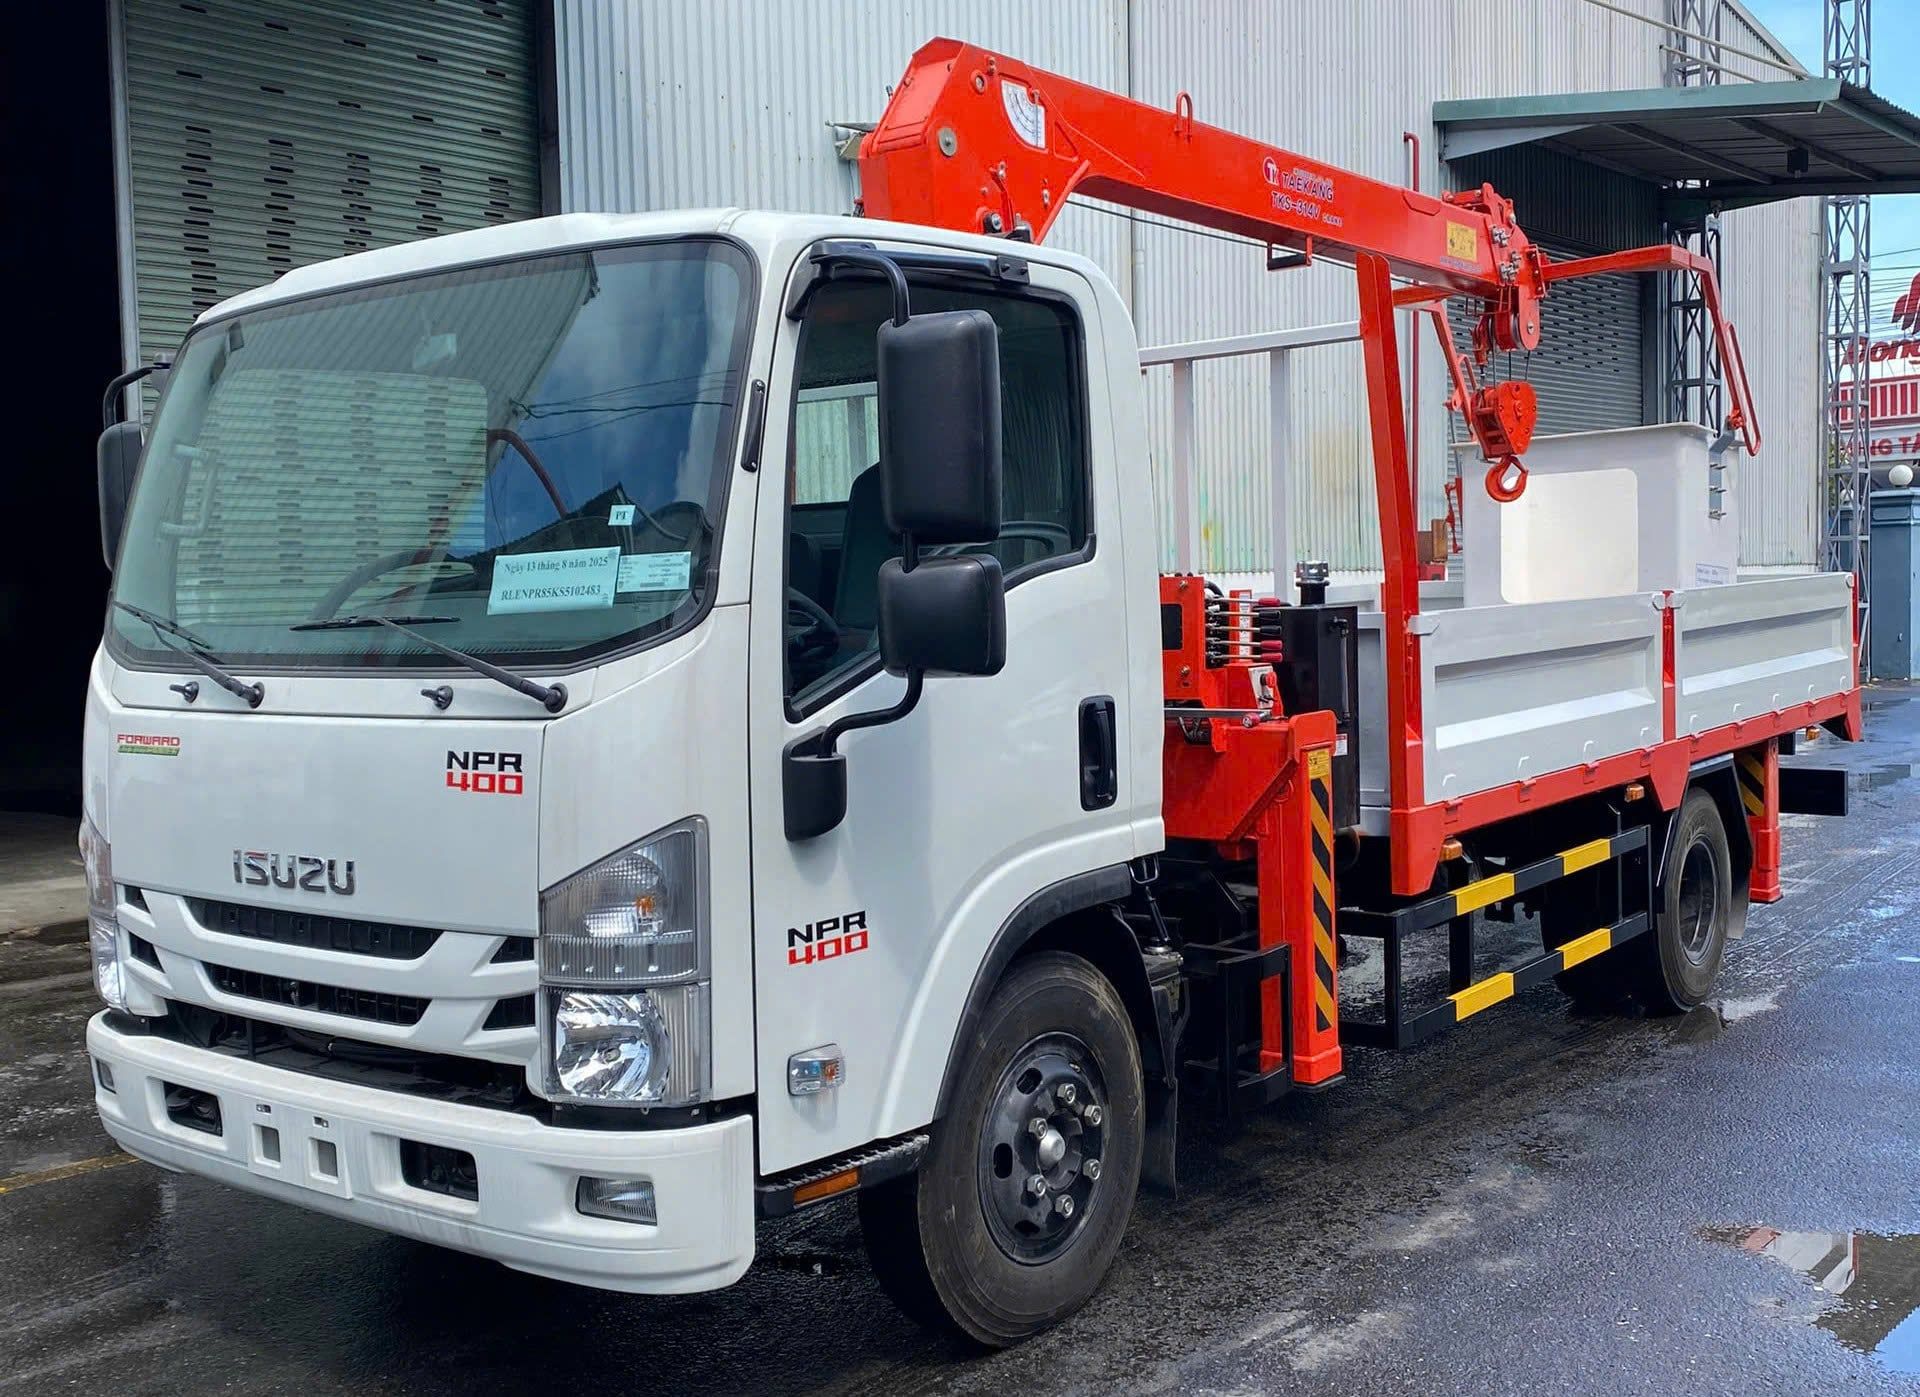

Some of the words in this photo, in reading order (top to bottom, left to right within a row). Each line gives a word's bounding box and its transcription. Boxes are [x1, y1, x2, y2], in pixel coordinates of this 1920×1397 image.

[1281, 171, 1335, 203] TAEKANG
[537, 560, 560, 574] tháng
[588, 556, 608, 567] 2025
[117, 734, 181, 746] FORWARD
[446, 750, 523, 772] NPR
[446, 771, 523, 795] 400
[233, 849, 355, 895] ISUZU
[787, 910, 867, 948] NPR
[788, 930, 868, 965] 400
